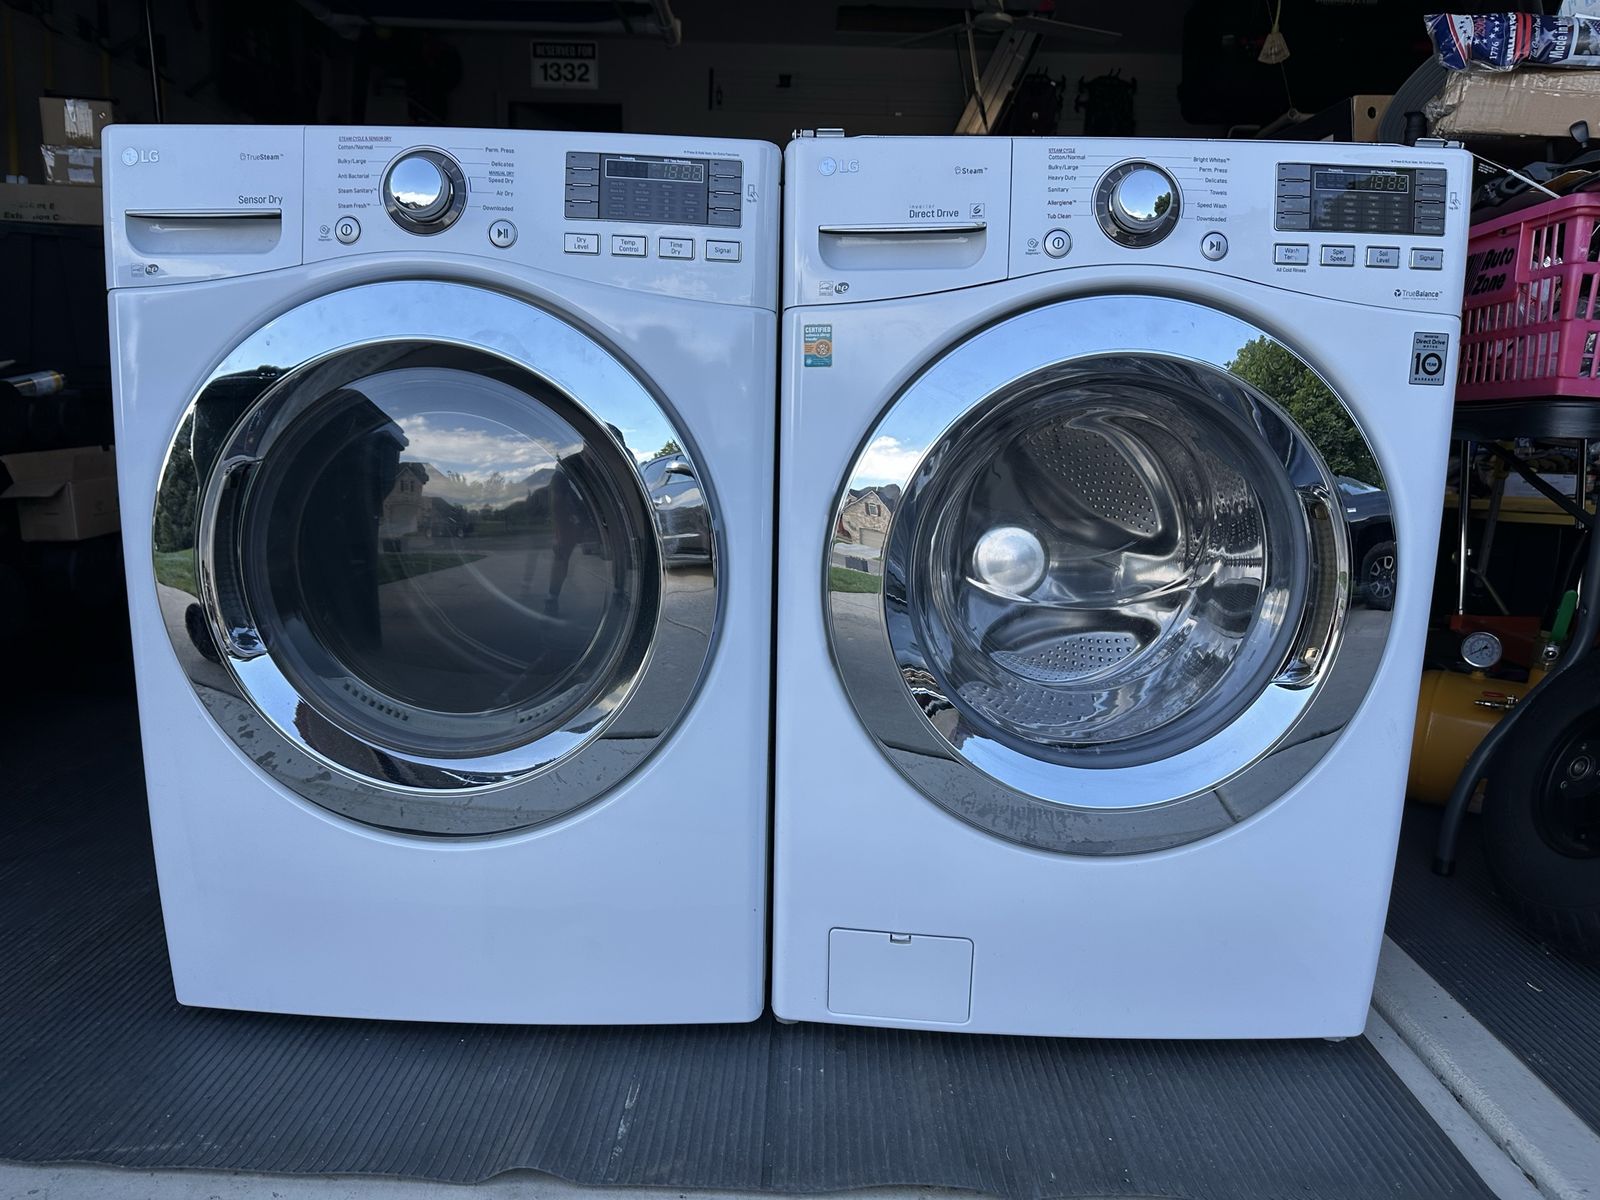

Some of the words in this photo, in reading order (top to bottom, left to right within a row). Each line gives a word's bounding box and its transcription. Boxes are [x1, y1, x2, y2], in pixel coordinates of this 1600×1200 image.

[1554, 26, 1568, 34] in
[1506, 25, 1516, 61] VALLEY
[1548, 35, 1567, 59] Made
[1489, 41, 1500, 59] 1776
[539, 62, 590, 82] 1332
[140, 150, 160, 163] LG
[839, 159, 861, 173] LG
[504, 190, 514, 198] Dry
[238, 195, 267, 205] Sensor
[268, 195, 283, 205] Dry
[909, 209, 935, 218] Direct
[936, 208, 960, 218] Drive
[576, 236, 587, 244] Dry
[621, 239, 636, 247] Temp
[574, 242, 589, 250] Level
[714, 246, 732, 254] Signal
[670, 248, 681, 256] Dry
[1332, 249, 1344, 257] Spin
[1330, 255, 1346, 263] Speed
[1376, 256, 1390, 264] Level
[1420, 254, 1434, 262] Signal
[1480, 247, 1514, 271] Auto
[1472, 272, 1506, 296] Zone
[1414, 352, 1442, 376] 10
